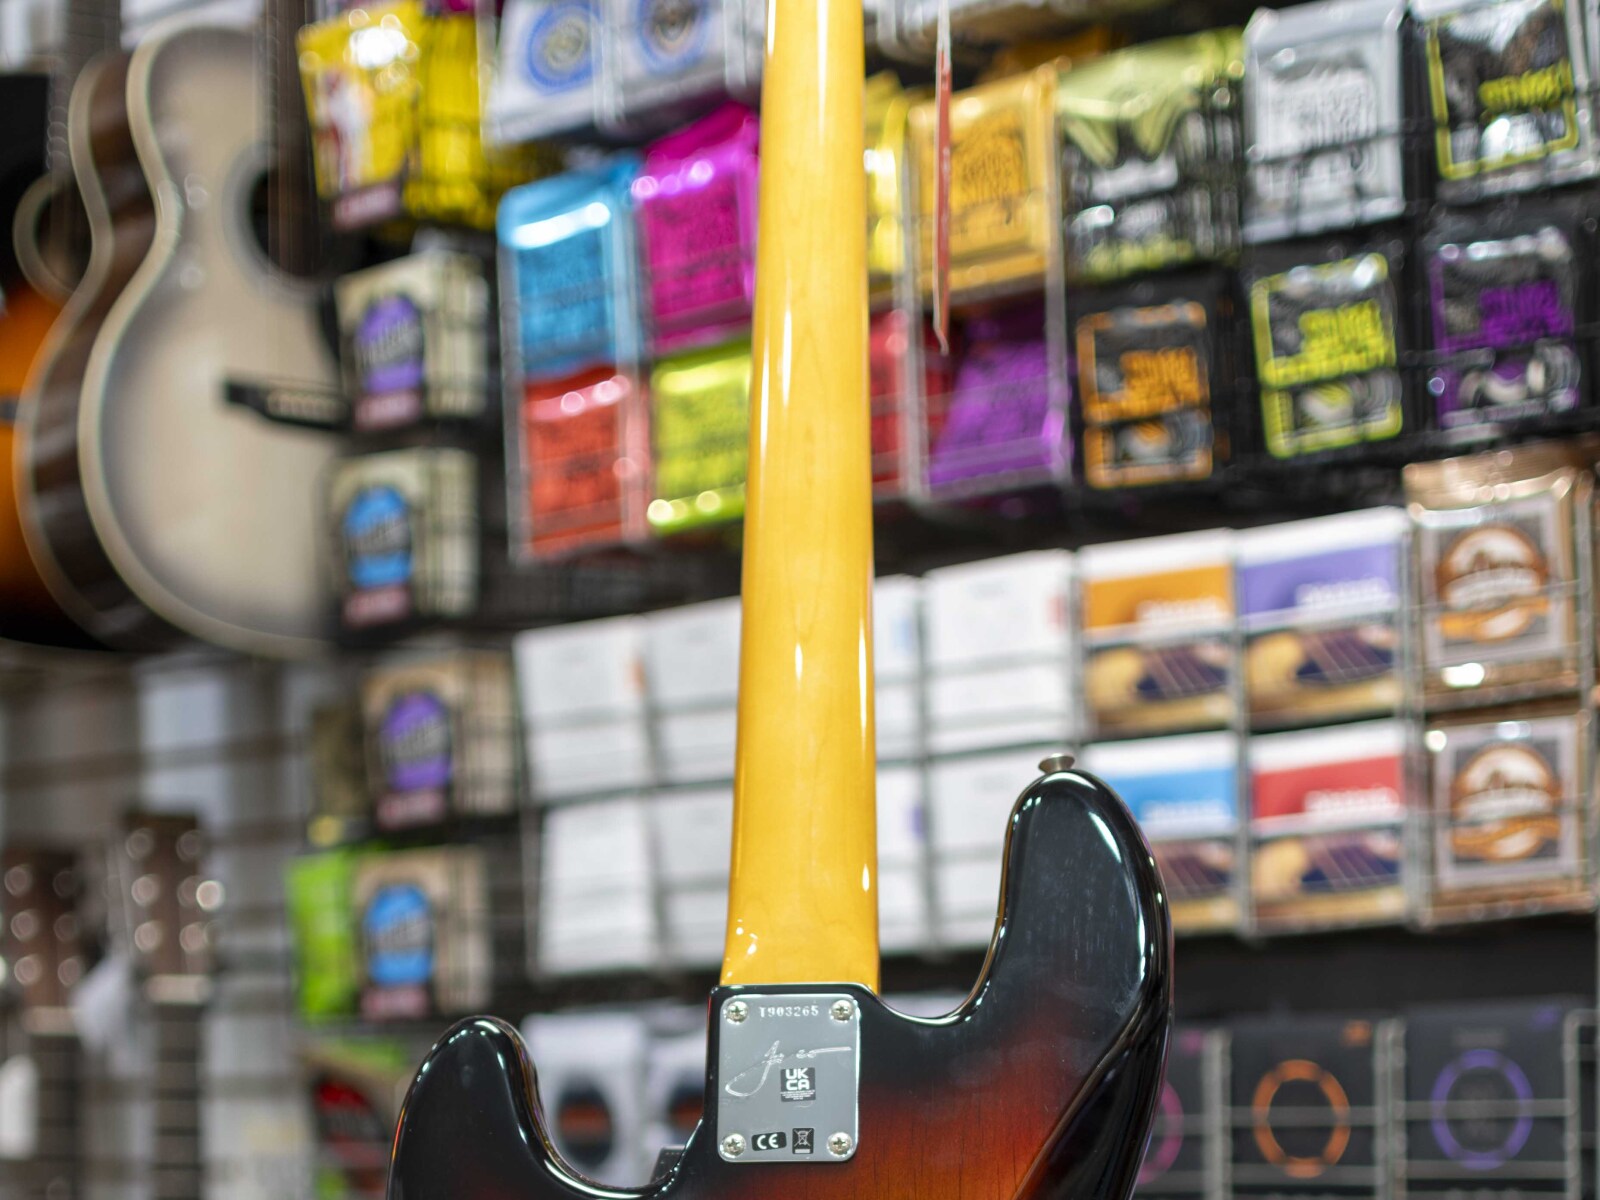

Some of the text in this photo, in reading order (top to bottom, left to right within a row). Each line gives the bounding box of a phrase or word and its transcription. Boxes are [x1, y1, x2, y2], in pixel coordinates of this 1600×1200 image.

[785, 1068, 809, 1080] UK
[785, 1079, 810, 1091] CA
[756, 1133, 779, 1150] CE
